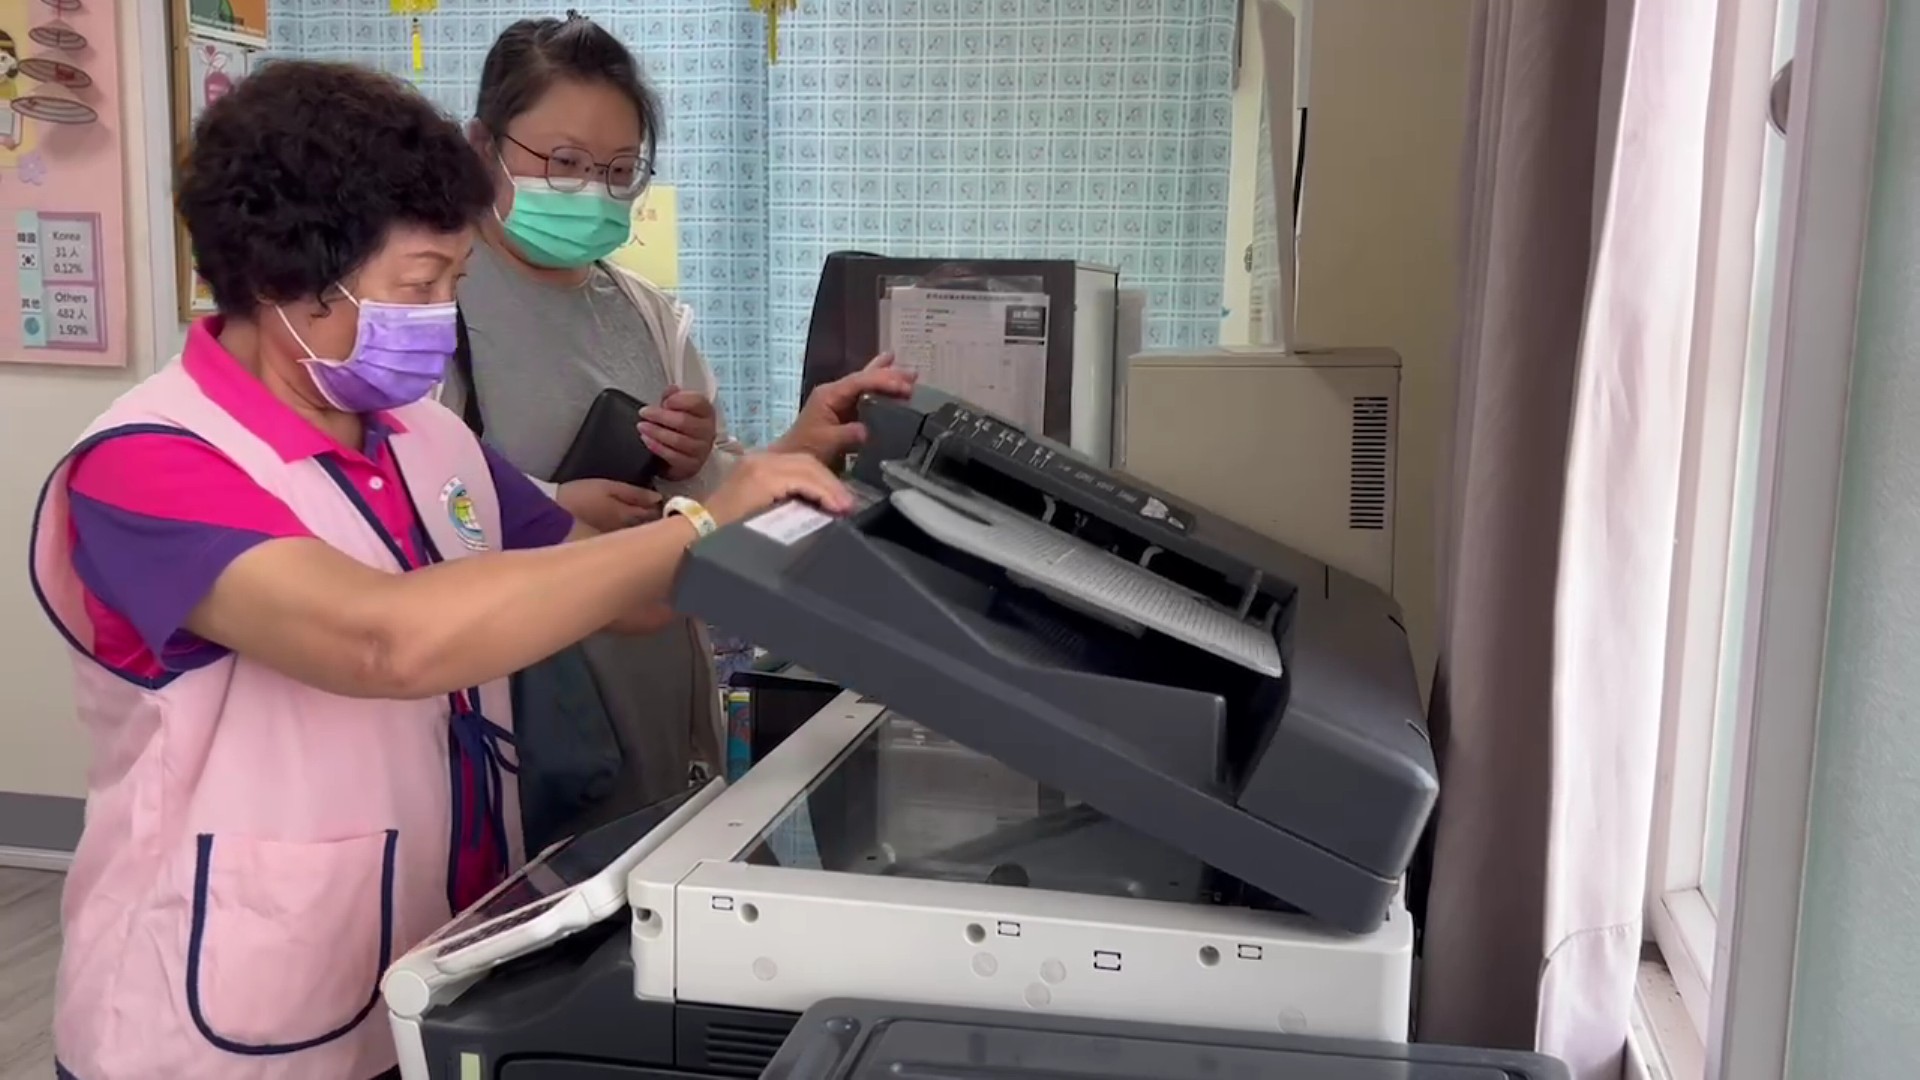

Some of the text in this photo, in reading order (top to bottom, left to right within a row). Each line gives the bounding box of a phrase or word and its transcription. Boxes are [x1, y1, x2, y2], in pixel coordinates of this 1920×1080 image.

[52, 231, 81, 241] Korea
[55, 247, 79, 258] 31 人
[53, 263, 83, 274] 0.12%
[21, 298, 41, 309] 其他
[54, 292, 88, 304] Others
[57, 308, 87, 320] 482 人
[59, 324, 88, 335] 1.92%
